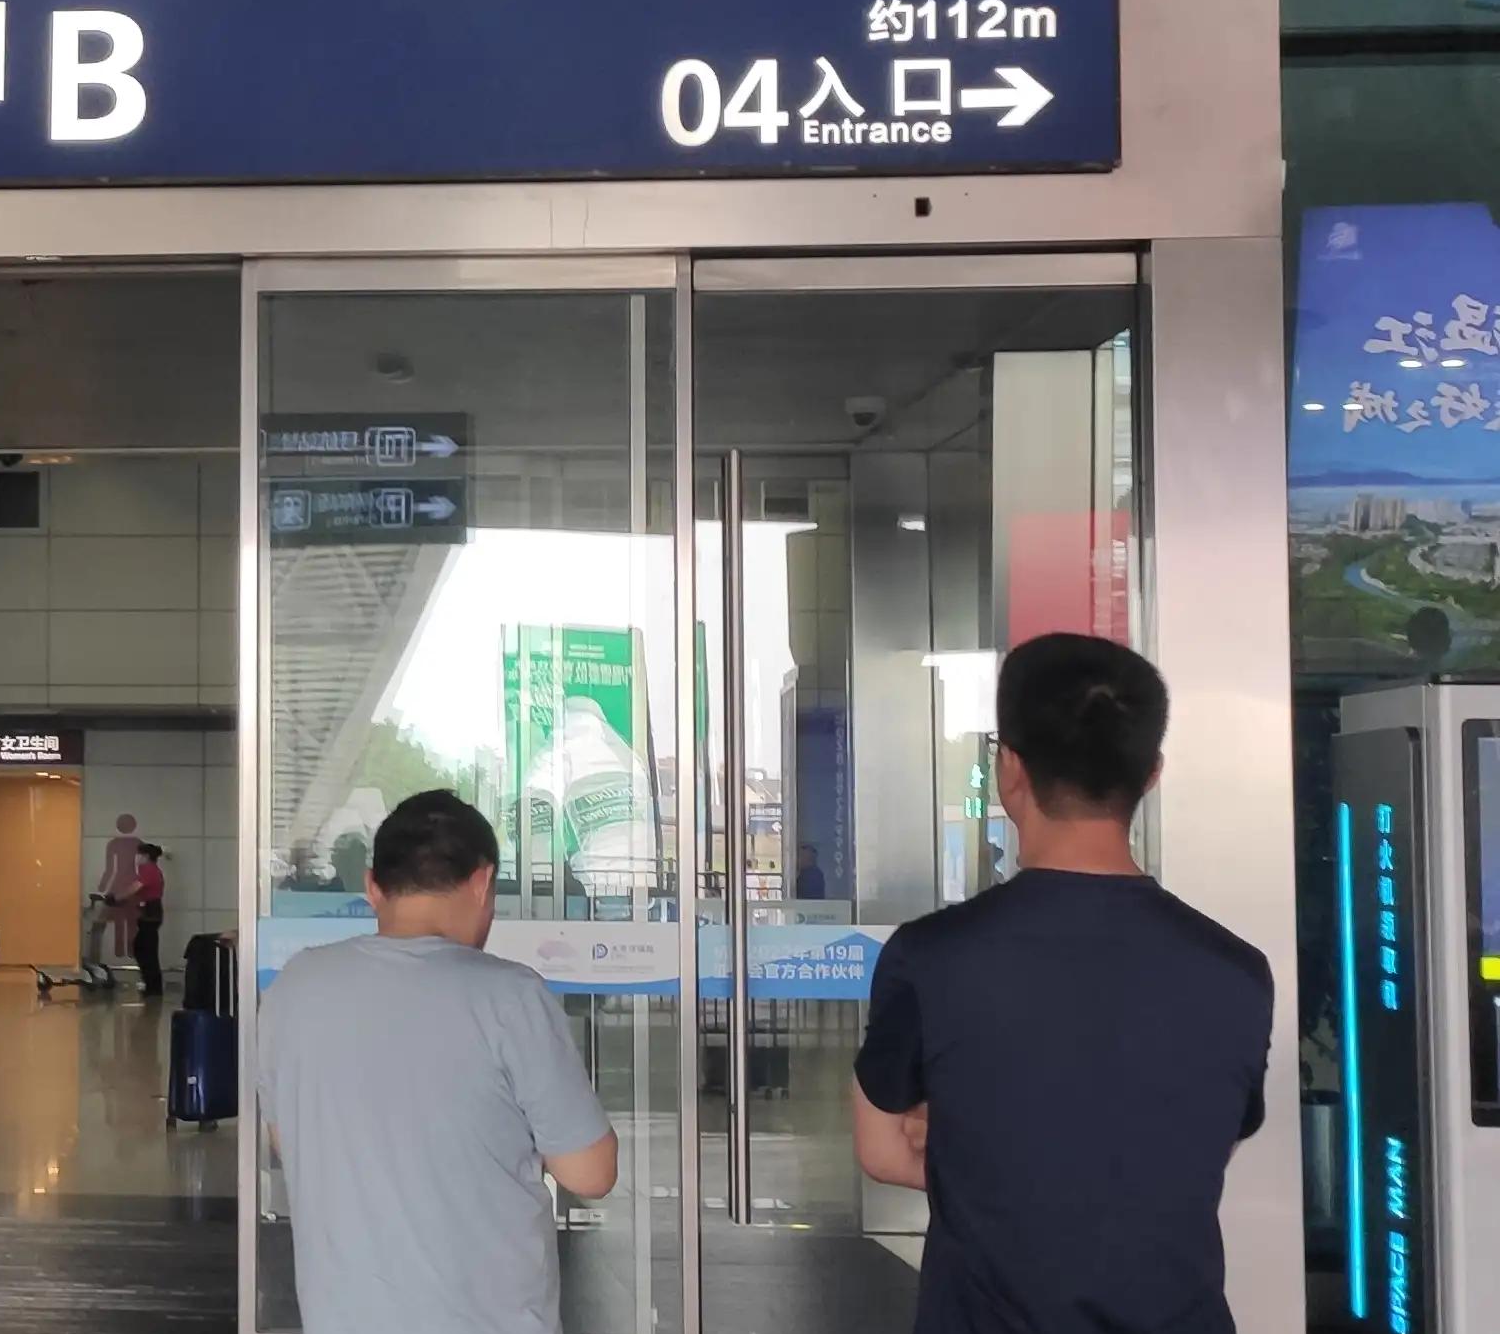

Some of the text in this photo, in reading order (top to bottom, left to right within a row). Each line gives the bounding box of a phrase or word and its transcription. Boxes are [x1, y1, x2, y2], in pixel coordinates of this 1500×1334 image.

[50, 10, 147, 141] B
[661, 56, 952, 147] 04 入口
[803, 118, 952, 144] Entrance
[0, 735, 59, 751] 女卫生间
